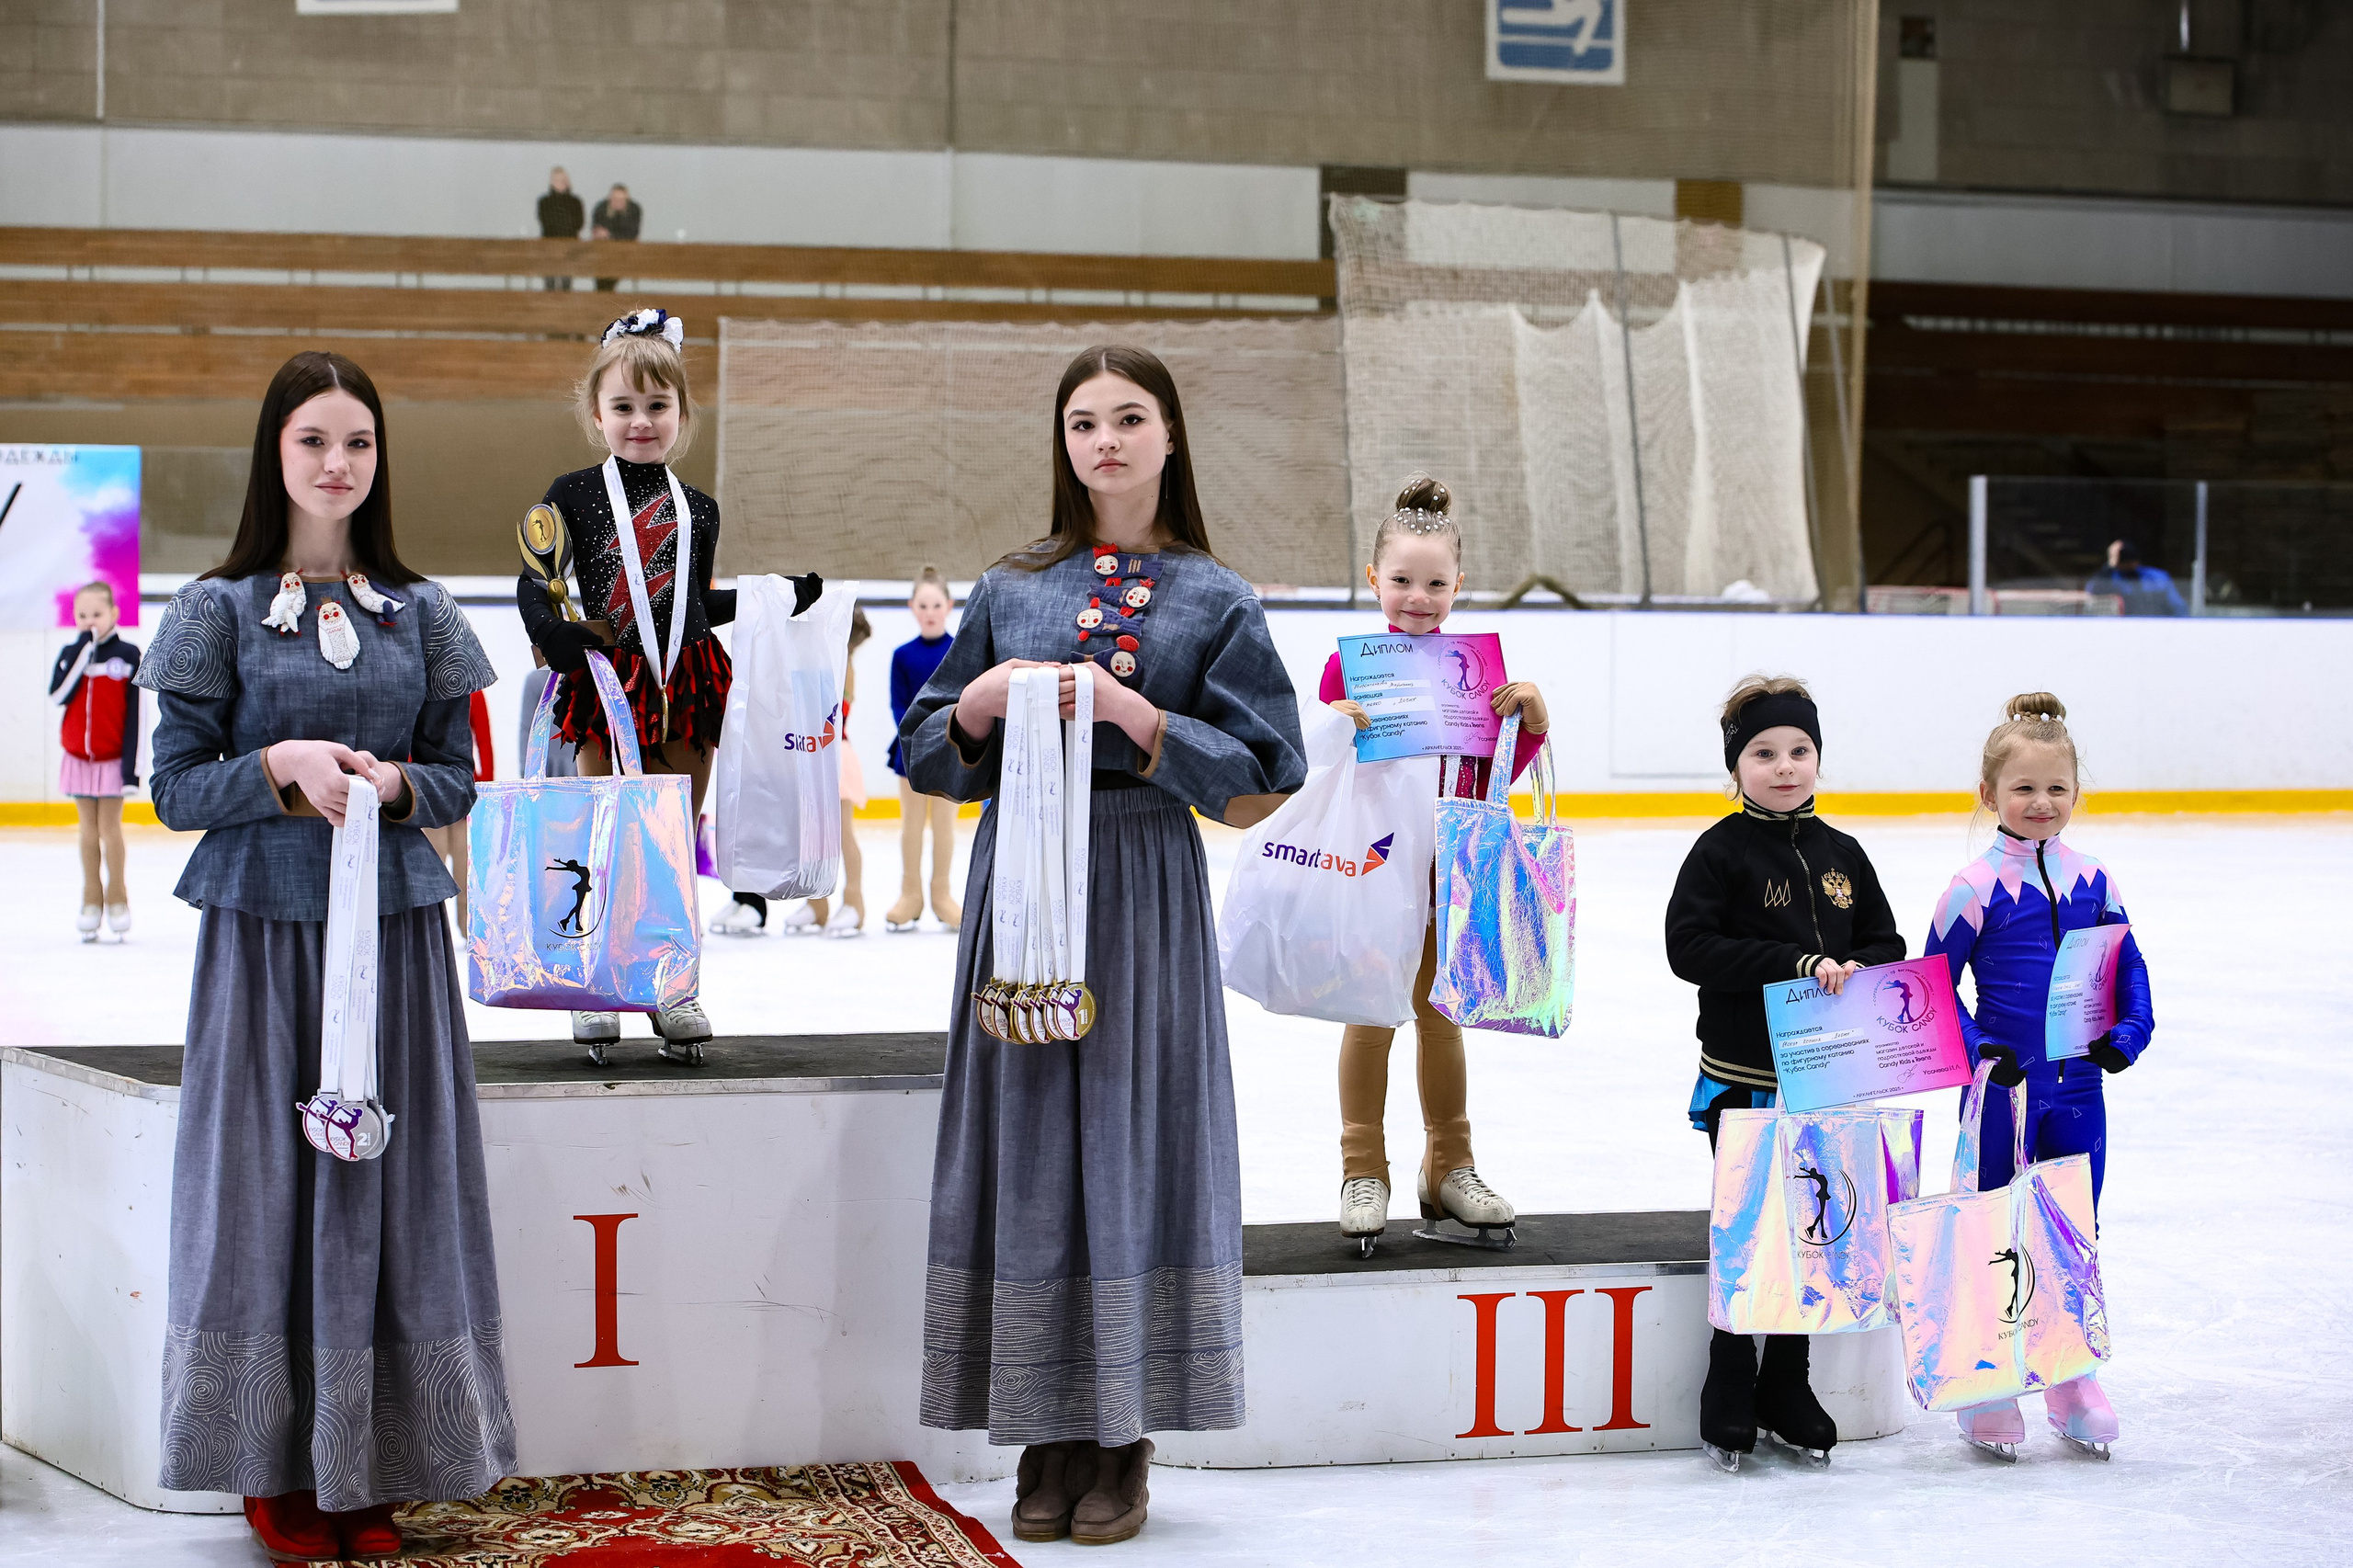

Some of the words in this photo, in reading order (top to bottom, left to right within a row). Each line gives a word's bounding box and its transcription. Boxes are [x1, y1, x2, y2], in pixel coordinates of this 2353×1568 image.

[0, 449, 79, 466] ДЕЖДЫ
[1468, 679, 1491, 700] CANDY
[1262, 841, 1357, 878] smartava
[1876, 1016, 1908, 1034] КУБОК
[1911, 1006, 1938, 1032] CANDY
[1776, 1026, 1823, 1039] Награждается
[1789, 1048, 1815, 1060] участие
[1821, 1039, 1870, 1051] соревнованиях
[1790, 1054, 1827, 1065] фигурному
[1827, 1050, 1855, 1059] катанию
[1879, 1060, 1899, 1069] Candy
[1915, 1055, 1932, 1063] Teens
[1798, 1250, 1824, 1259] КУБОК
[1458, 1288, 1652, 1437] III
